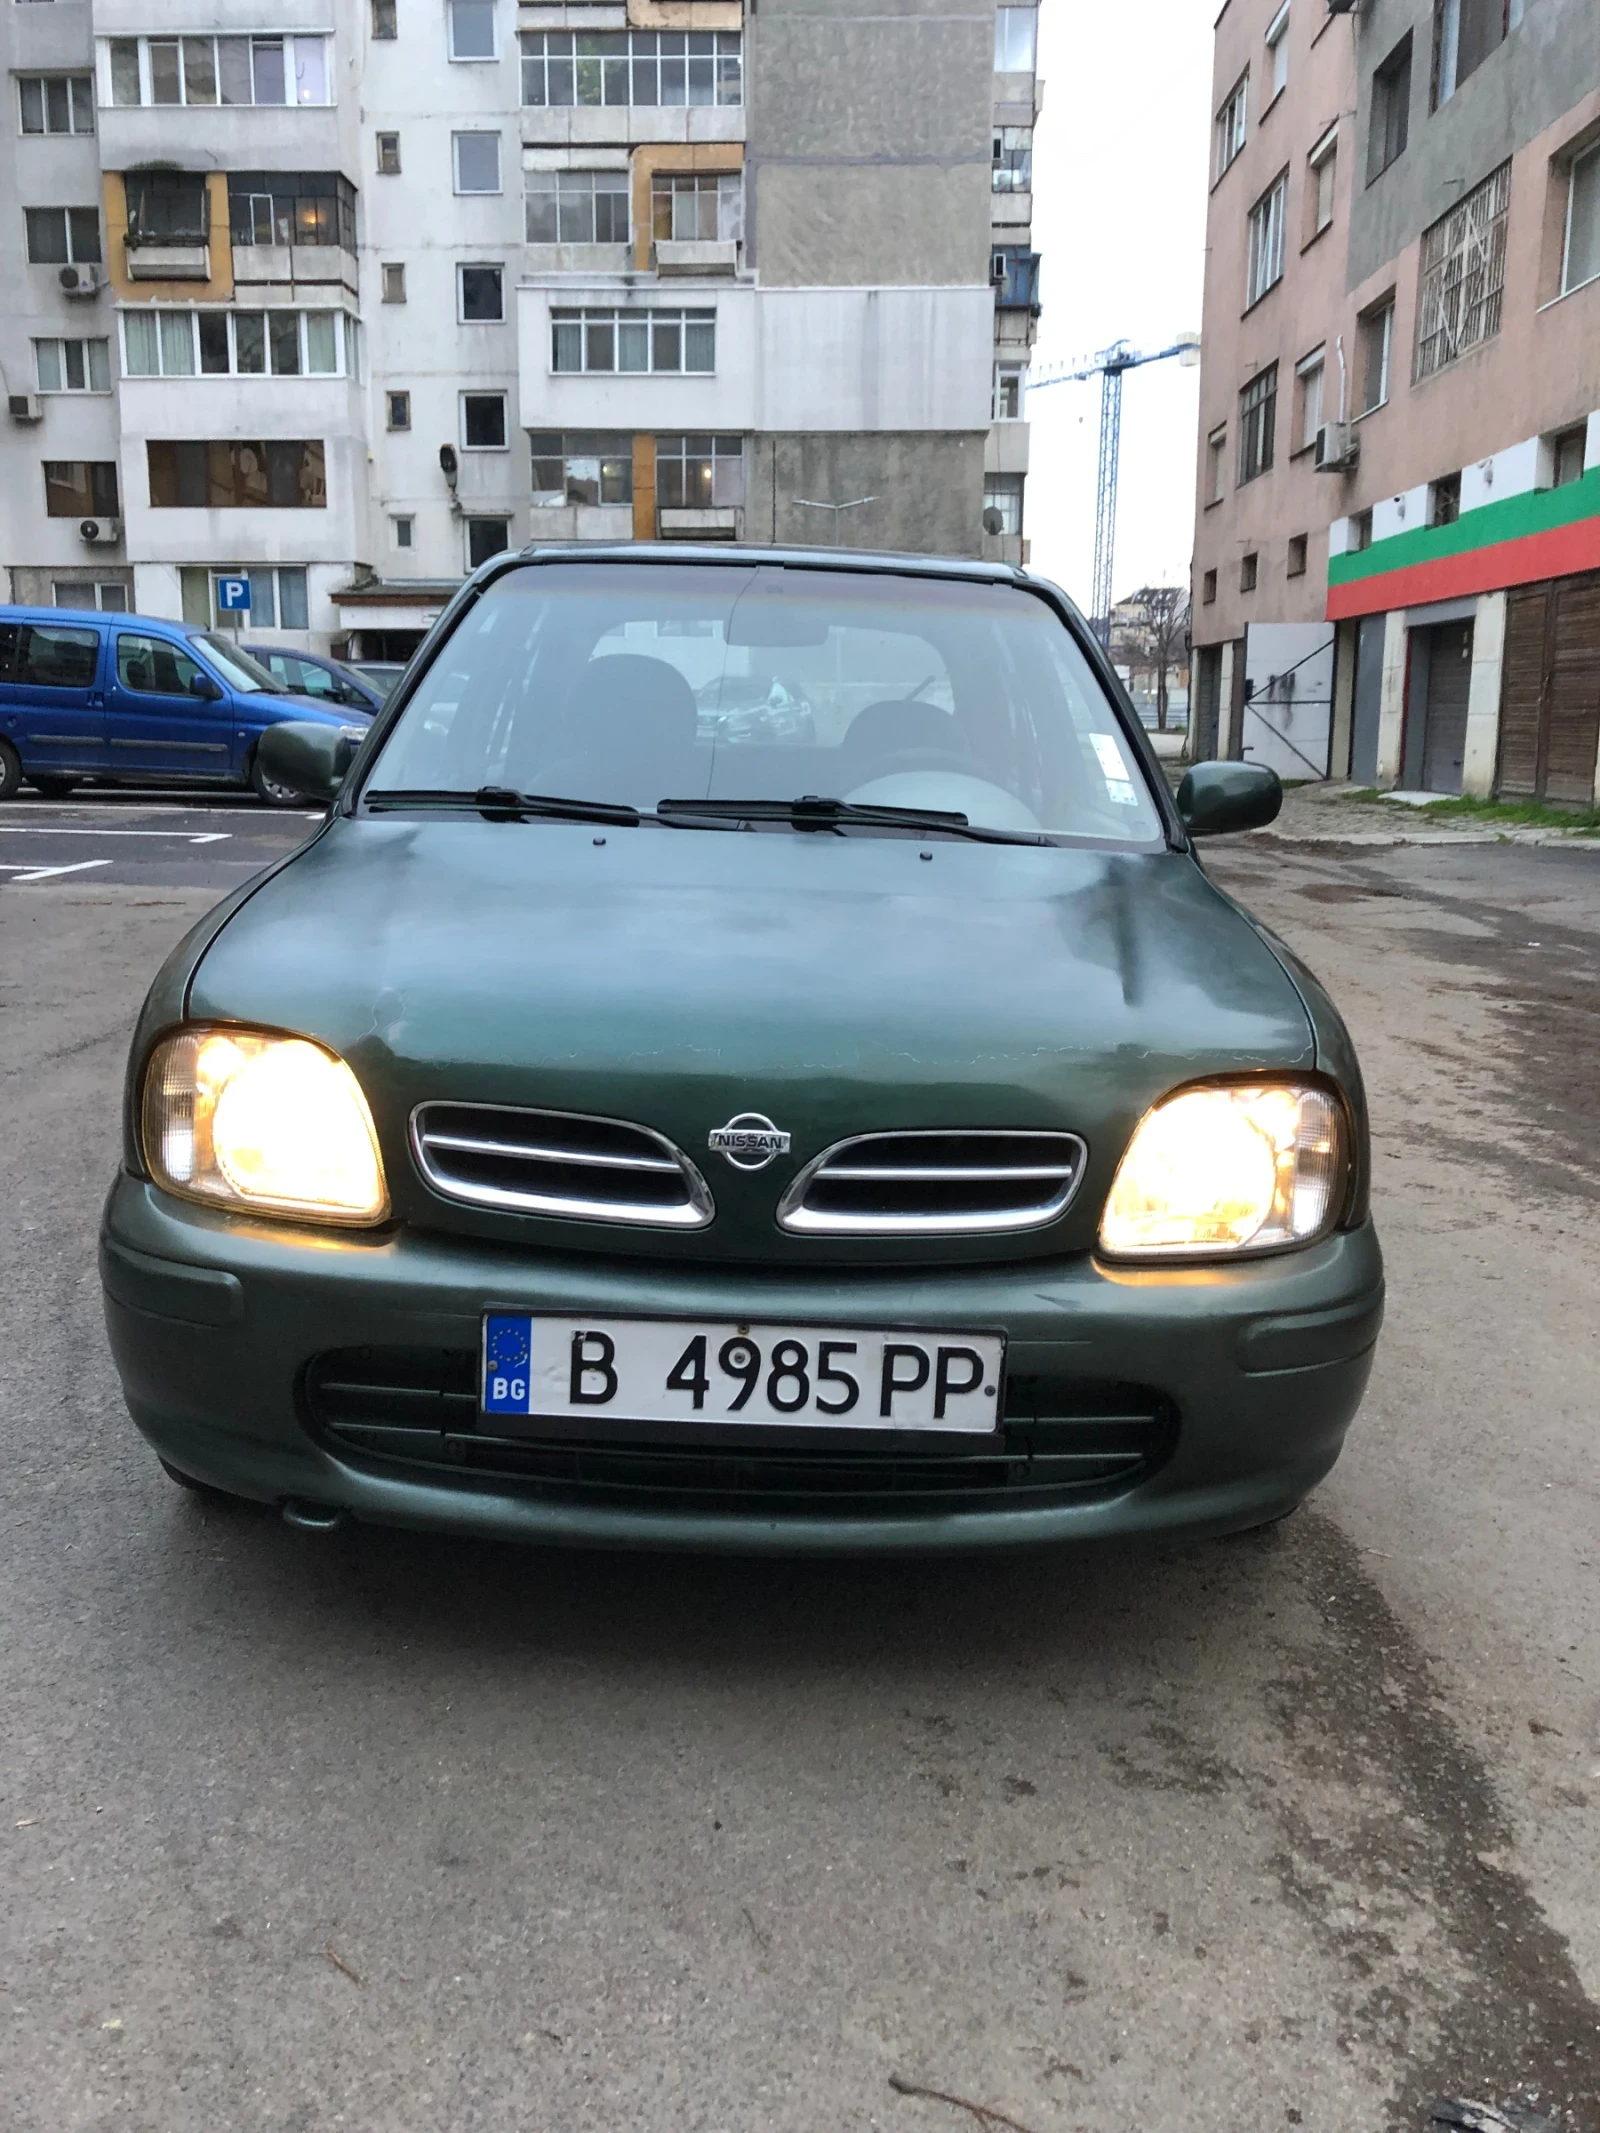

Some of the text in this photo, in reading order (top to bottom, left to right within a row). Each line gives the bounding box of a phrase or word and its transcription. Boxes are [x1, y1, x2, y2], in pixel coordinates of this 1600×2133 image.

[226, 582, 244, 607] P
[719, 1134, 782, 1149] NISSAN
[569, 1330, 985, 1419] B 4985 PP
[493, 1378, 526, 1400] BG
